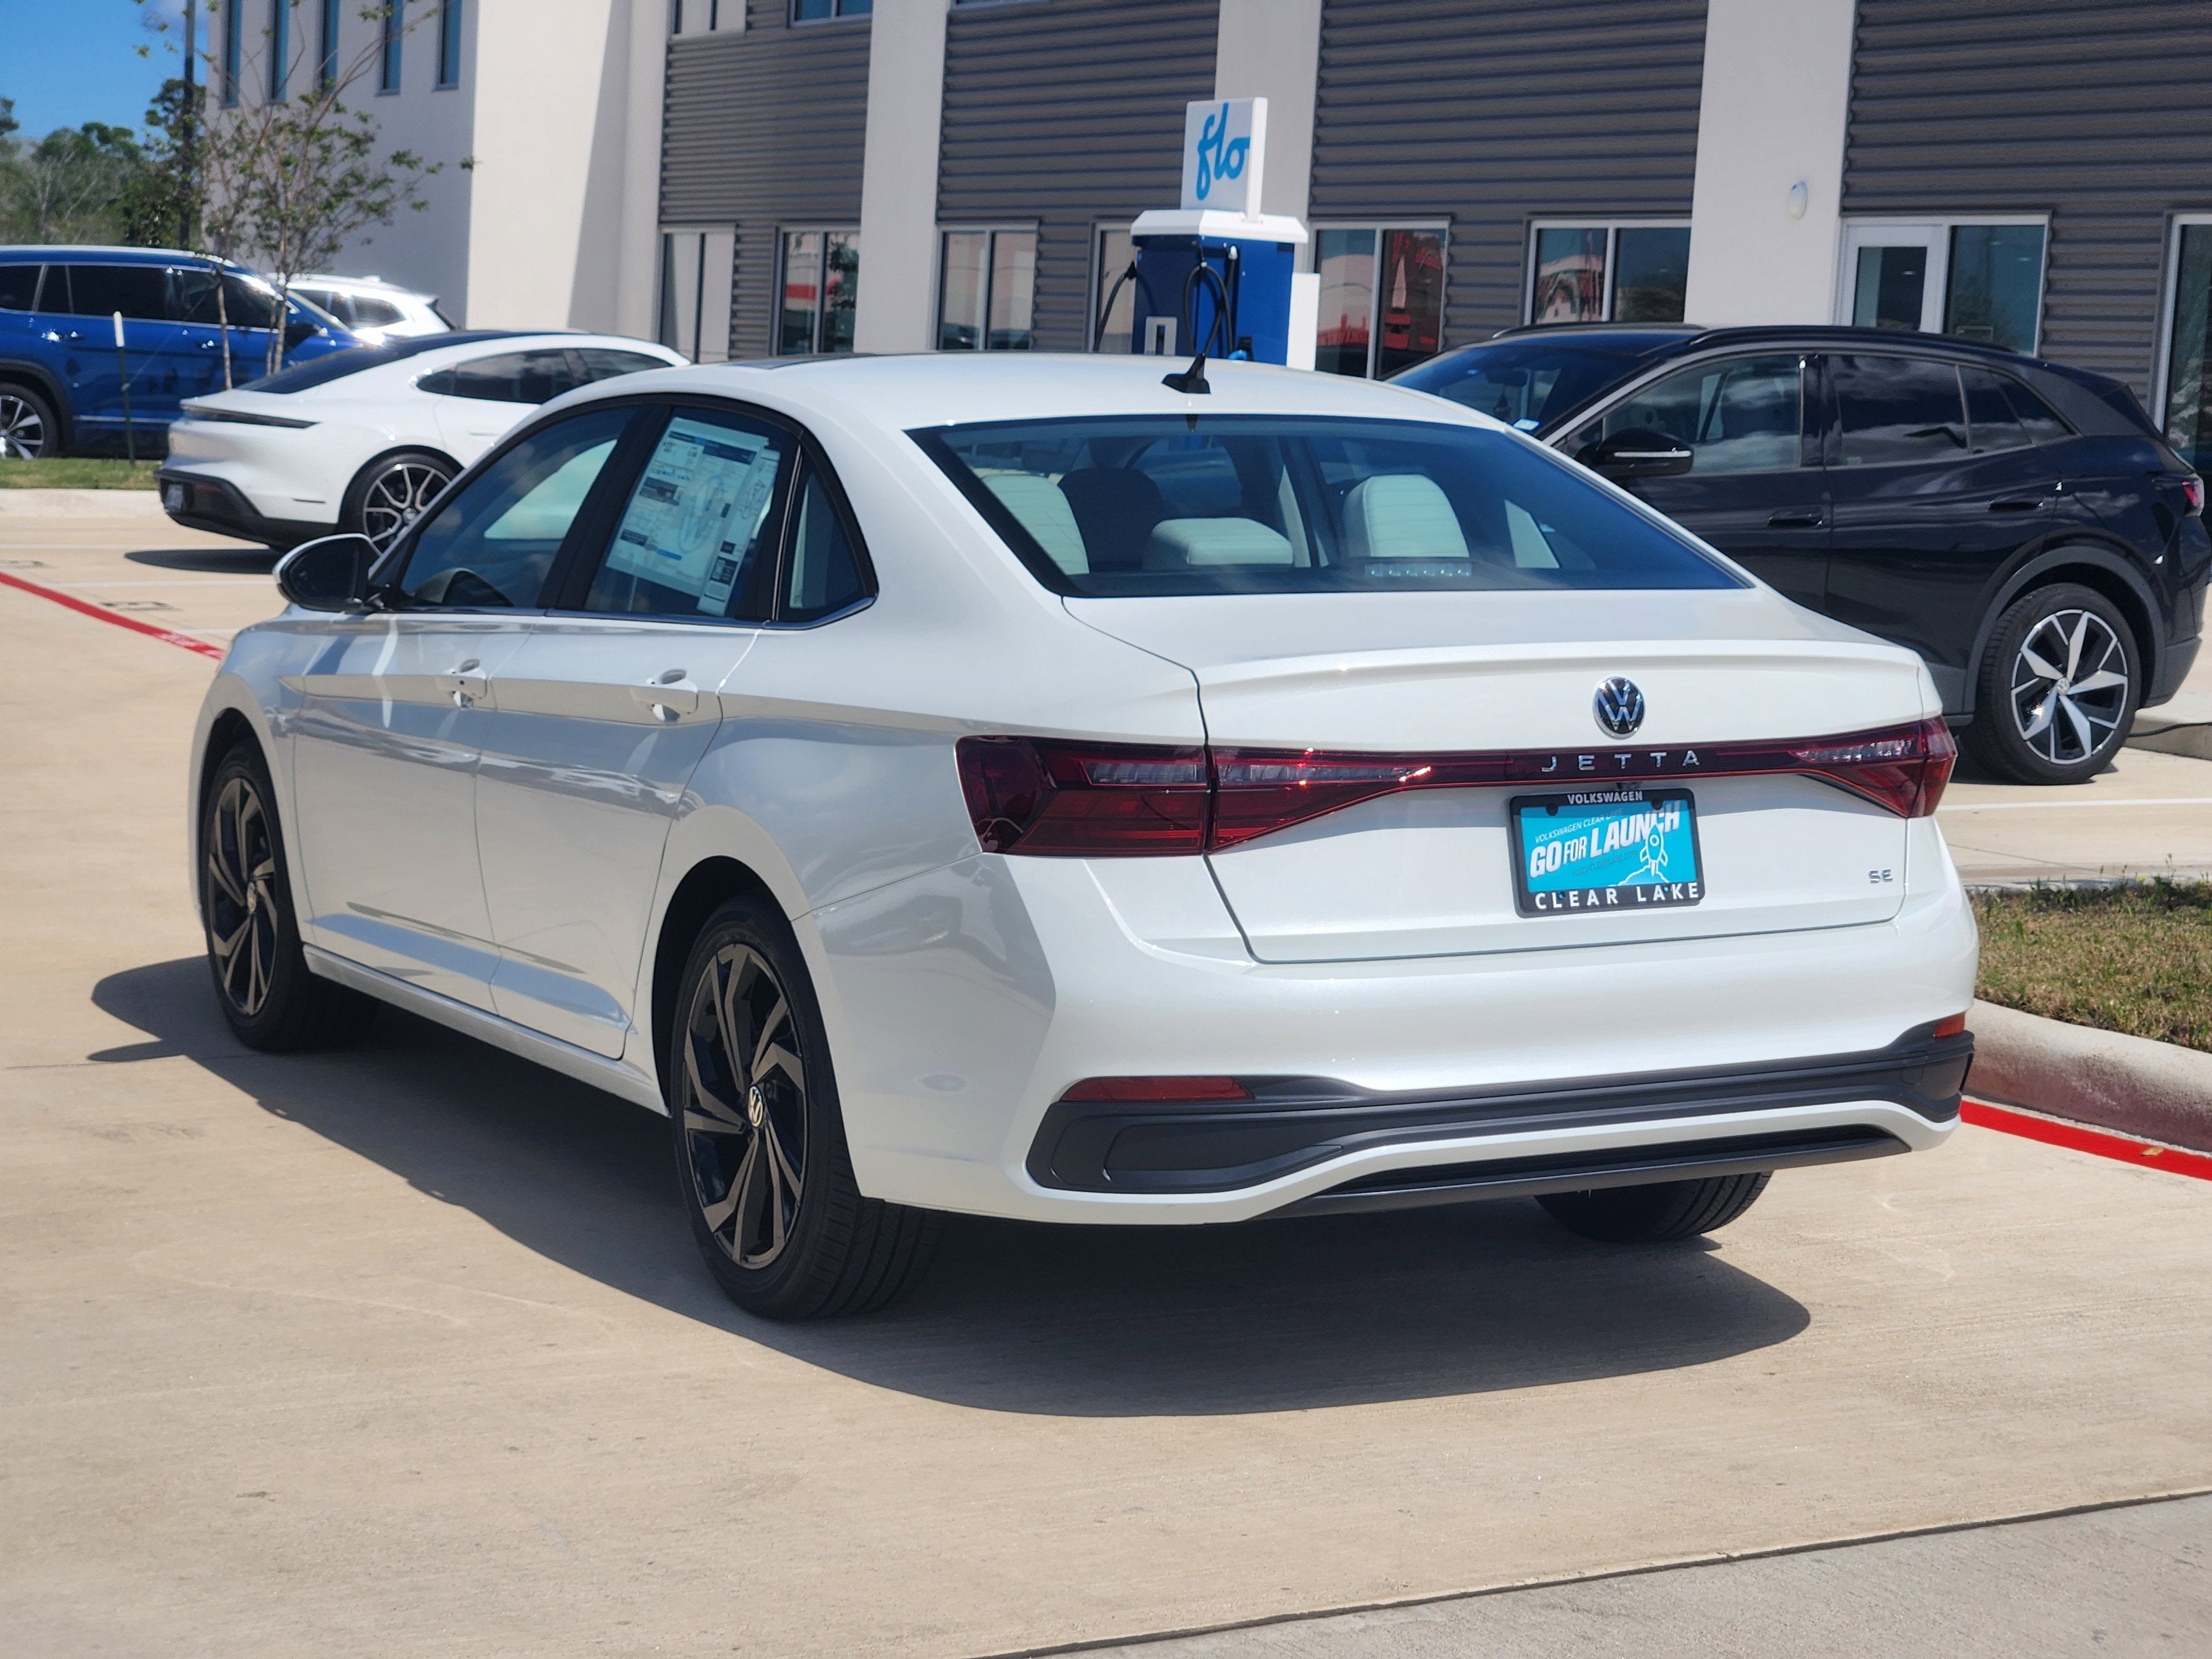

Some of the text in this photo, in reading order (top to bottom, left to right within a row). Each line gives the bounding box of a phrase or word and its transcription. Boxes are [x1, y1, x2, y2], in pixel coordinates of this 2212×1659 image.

[1196, 102, 1250, 201] flo
[1541, 750, 1700, 772] JETTA
[1567, 791, 1643, 805] VOLKSWAGEN
[1530, 800, 1681, 878] GO FOR LAUNCH
[1535, 808, 1624, 843] VOLKSWAGEN CLEAR LAKE
[1869, 869, 1893, 884] SE
[1535, 882, 1699, 910] CLEAR LAKE
